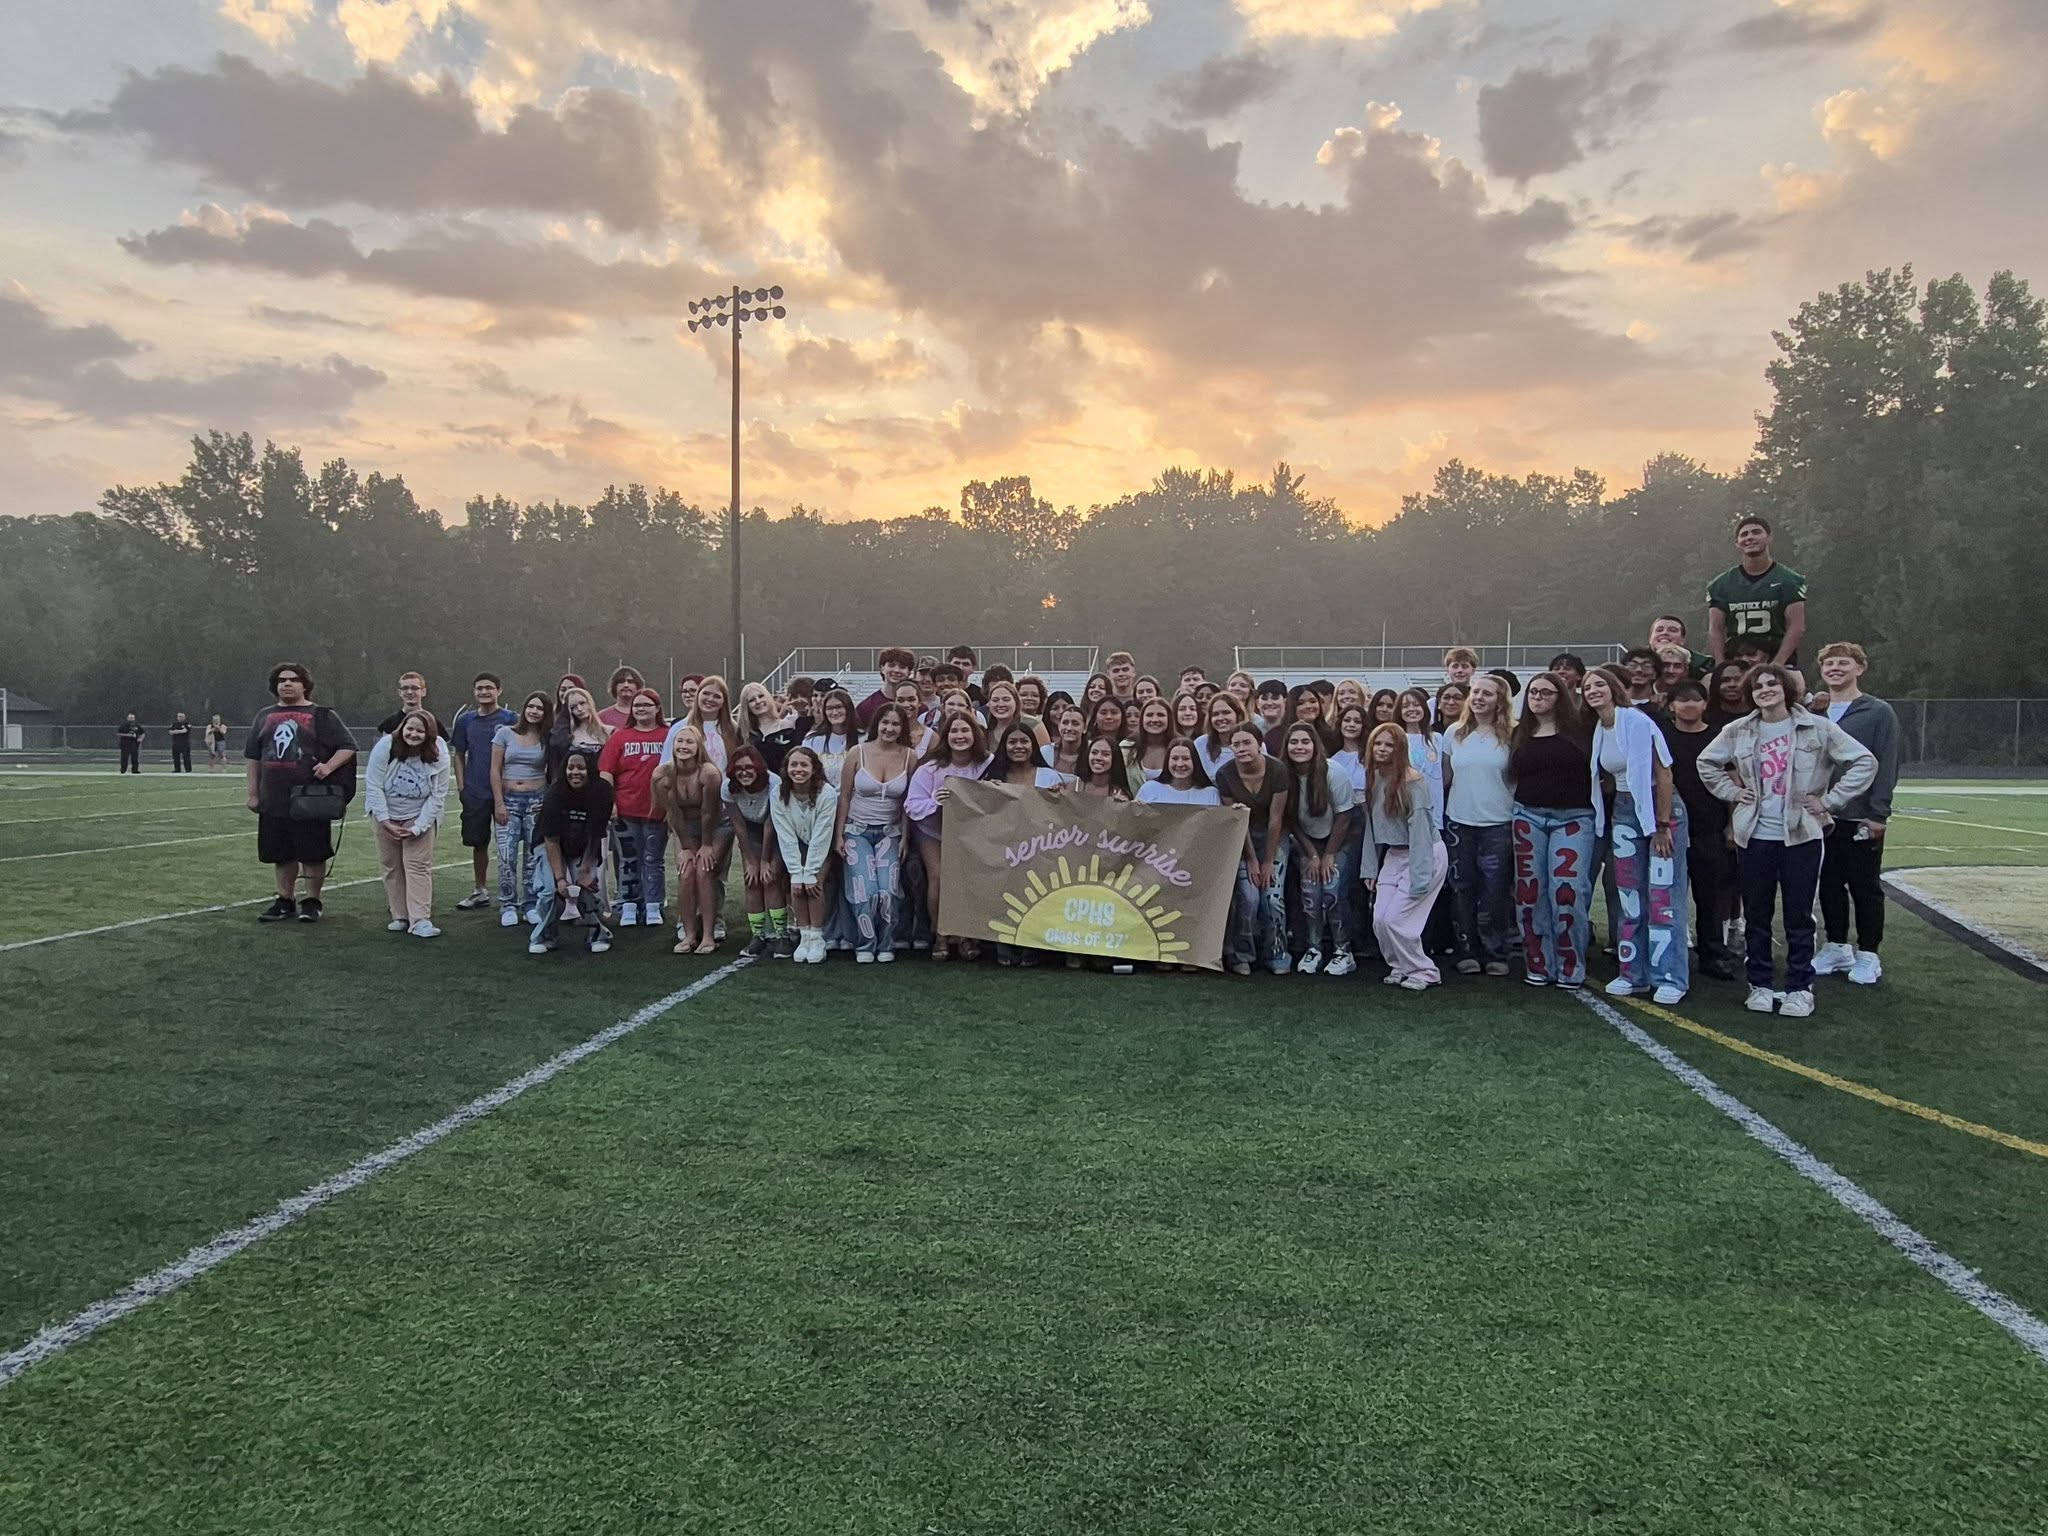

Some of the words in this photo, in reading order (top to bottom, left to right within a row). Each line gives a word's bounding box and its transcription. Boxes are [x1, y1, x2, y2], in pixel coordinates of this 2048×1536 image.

[624, 742, 640, 757] RED
[641, 741, 663, 754] WING
[1005, 823, 1089, 867] senior
[1096, 828, 1193, 888] sunrise
[1063, 898, 1115, 927] CPHS
